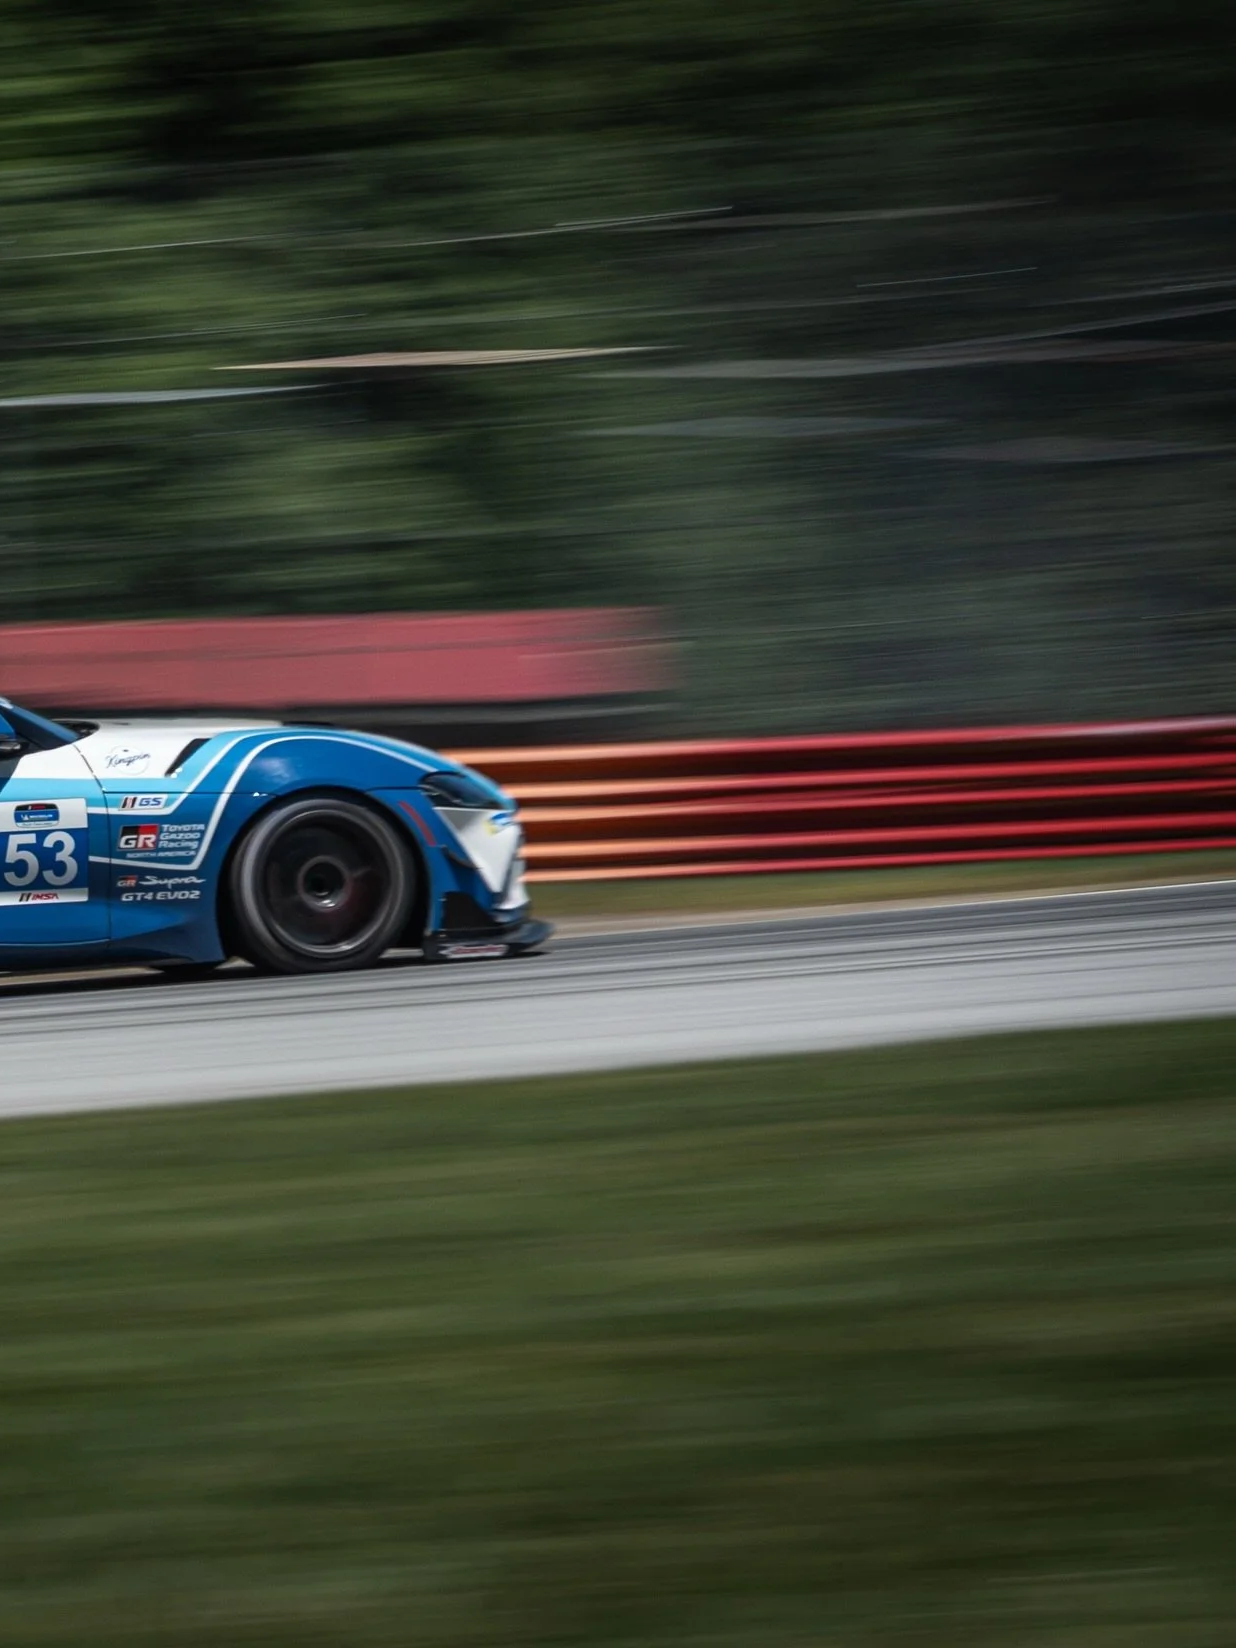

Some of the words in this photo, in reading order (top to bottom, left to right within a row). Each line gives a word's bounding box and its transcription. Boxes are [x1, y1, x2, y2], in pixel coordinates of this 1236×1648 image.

[138, 797, 164, 807] GS
[119, 834, 157, 849] GR
[161, 823, 205, 832] TOYOTA
[159, 832, 201, 841] GAZOO
[157, 840, 199, 850] Racing
[4, 830, 78, 887] 53
[138, 875, 207, 890] Supra
[120, 891, 154, 902] GT4
[155, 890, 202, 901] EVO2
